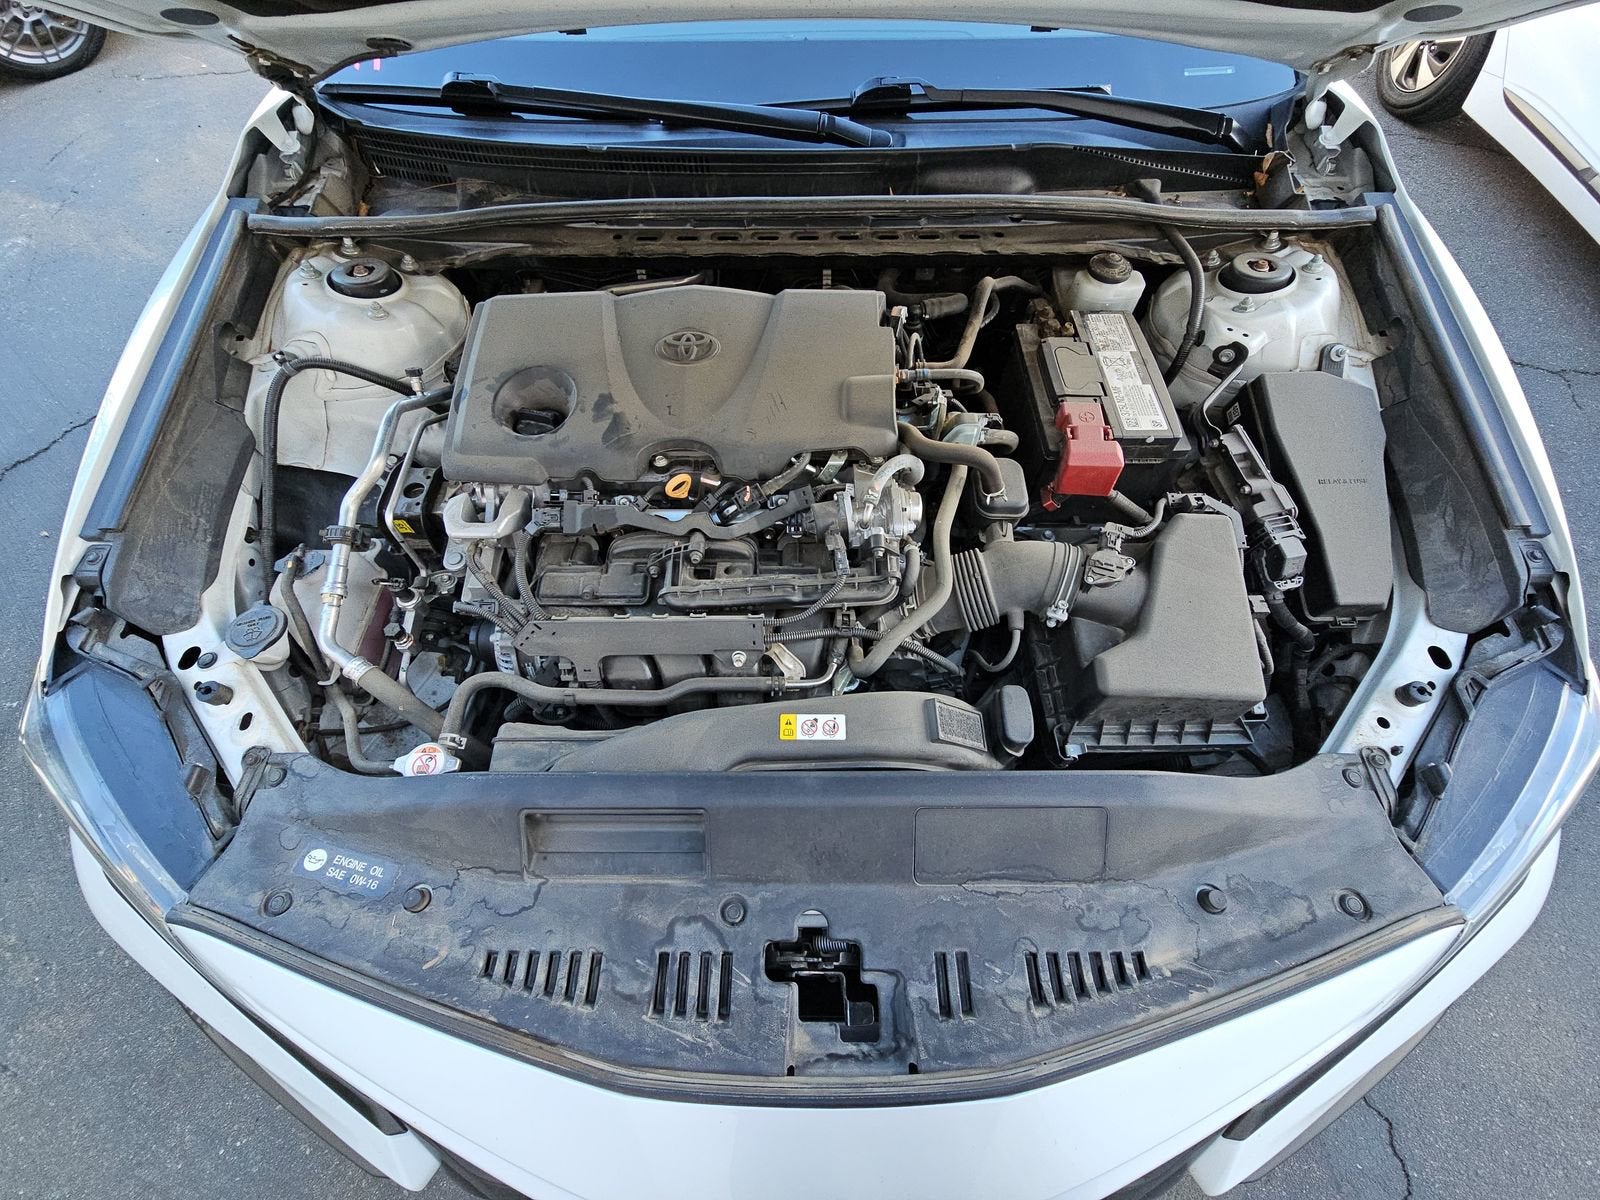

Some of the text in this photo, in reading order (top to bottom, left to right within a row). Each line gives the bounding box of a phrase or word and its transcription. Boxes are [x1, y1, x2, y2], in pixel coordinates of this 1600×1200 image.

[333, 854, 384, 878] ENGINE OIL
[326, 867, 379, 890] SAE 0W-16
